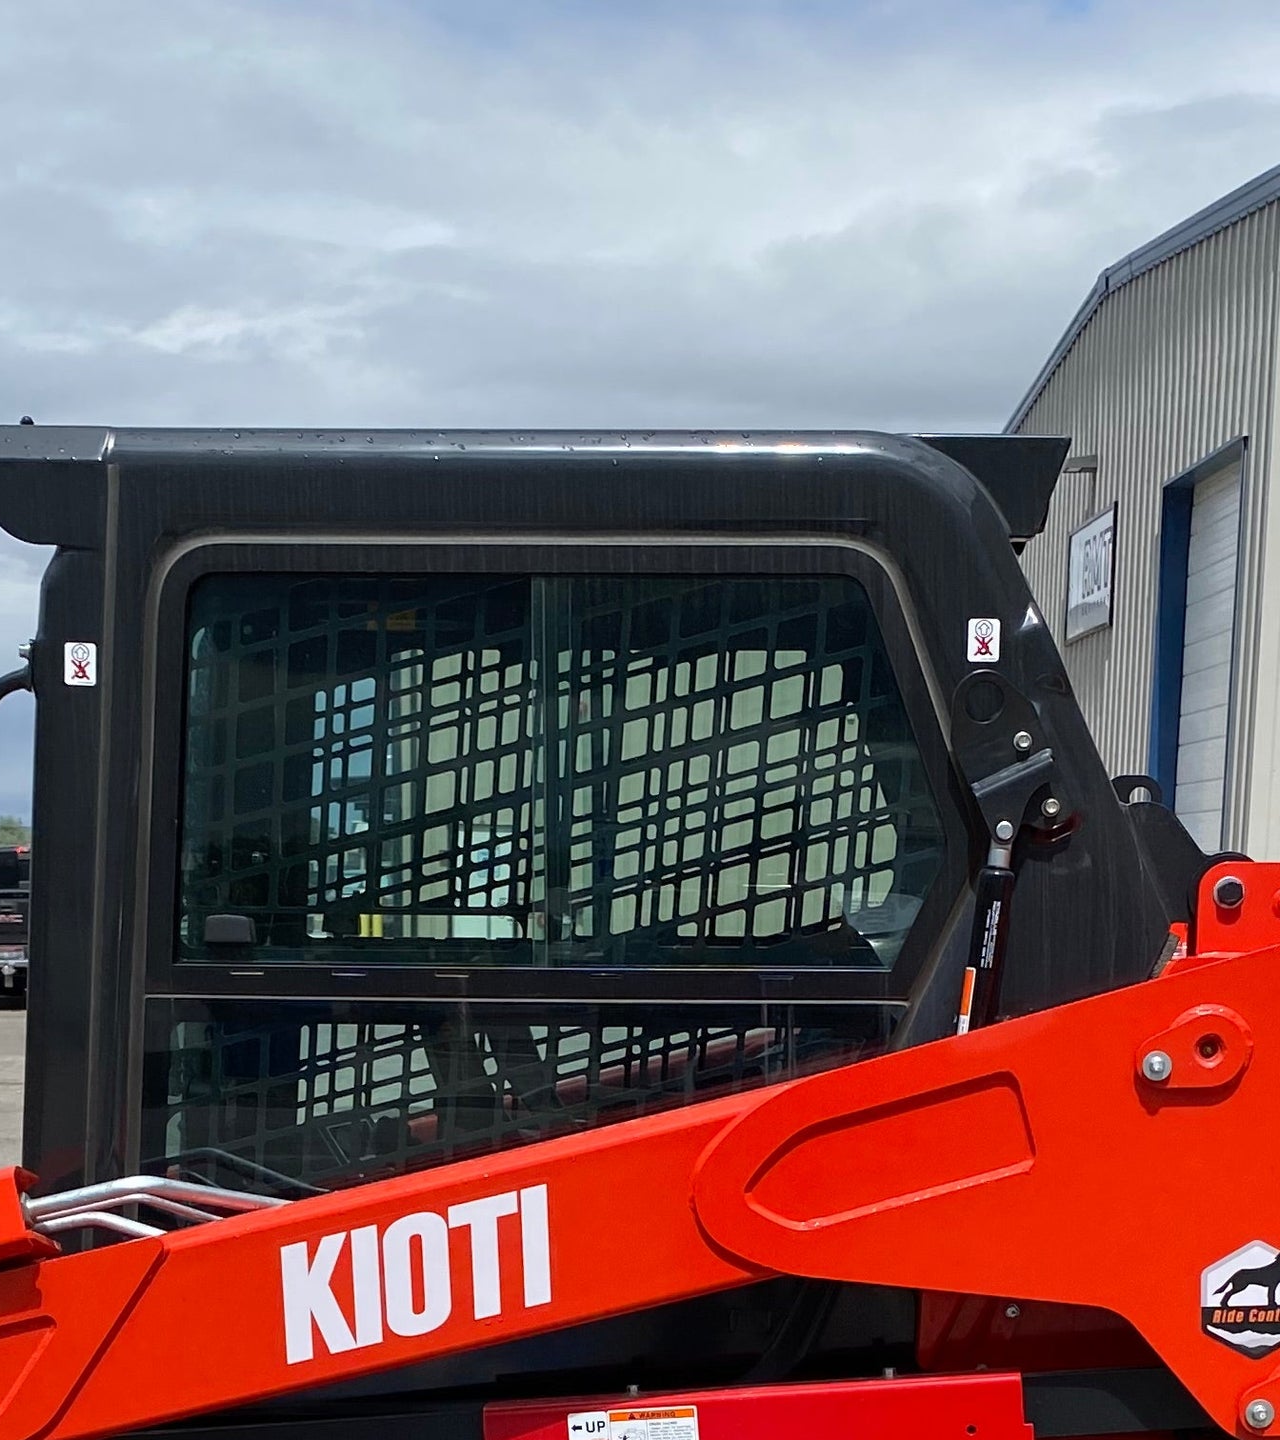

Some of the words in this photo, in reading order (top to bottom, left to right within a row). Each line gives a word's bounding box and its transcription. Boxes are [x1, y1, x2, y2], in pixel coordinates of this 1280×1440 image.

[281, 1183, 552, 1365] KIOTI
[1212, 1309, 1245, 1324] Ride
[639, 1411, 676, 1419] WARNING
[585, 1420, 606, 1433] UP
